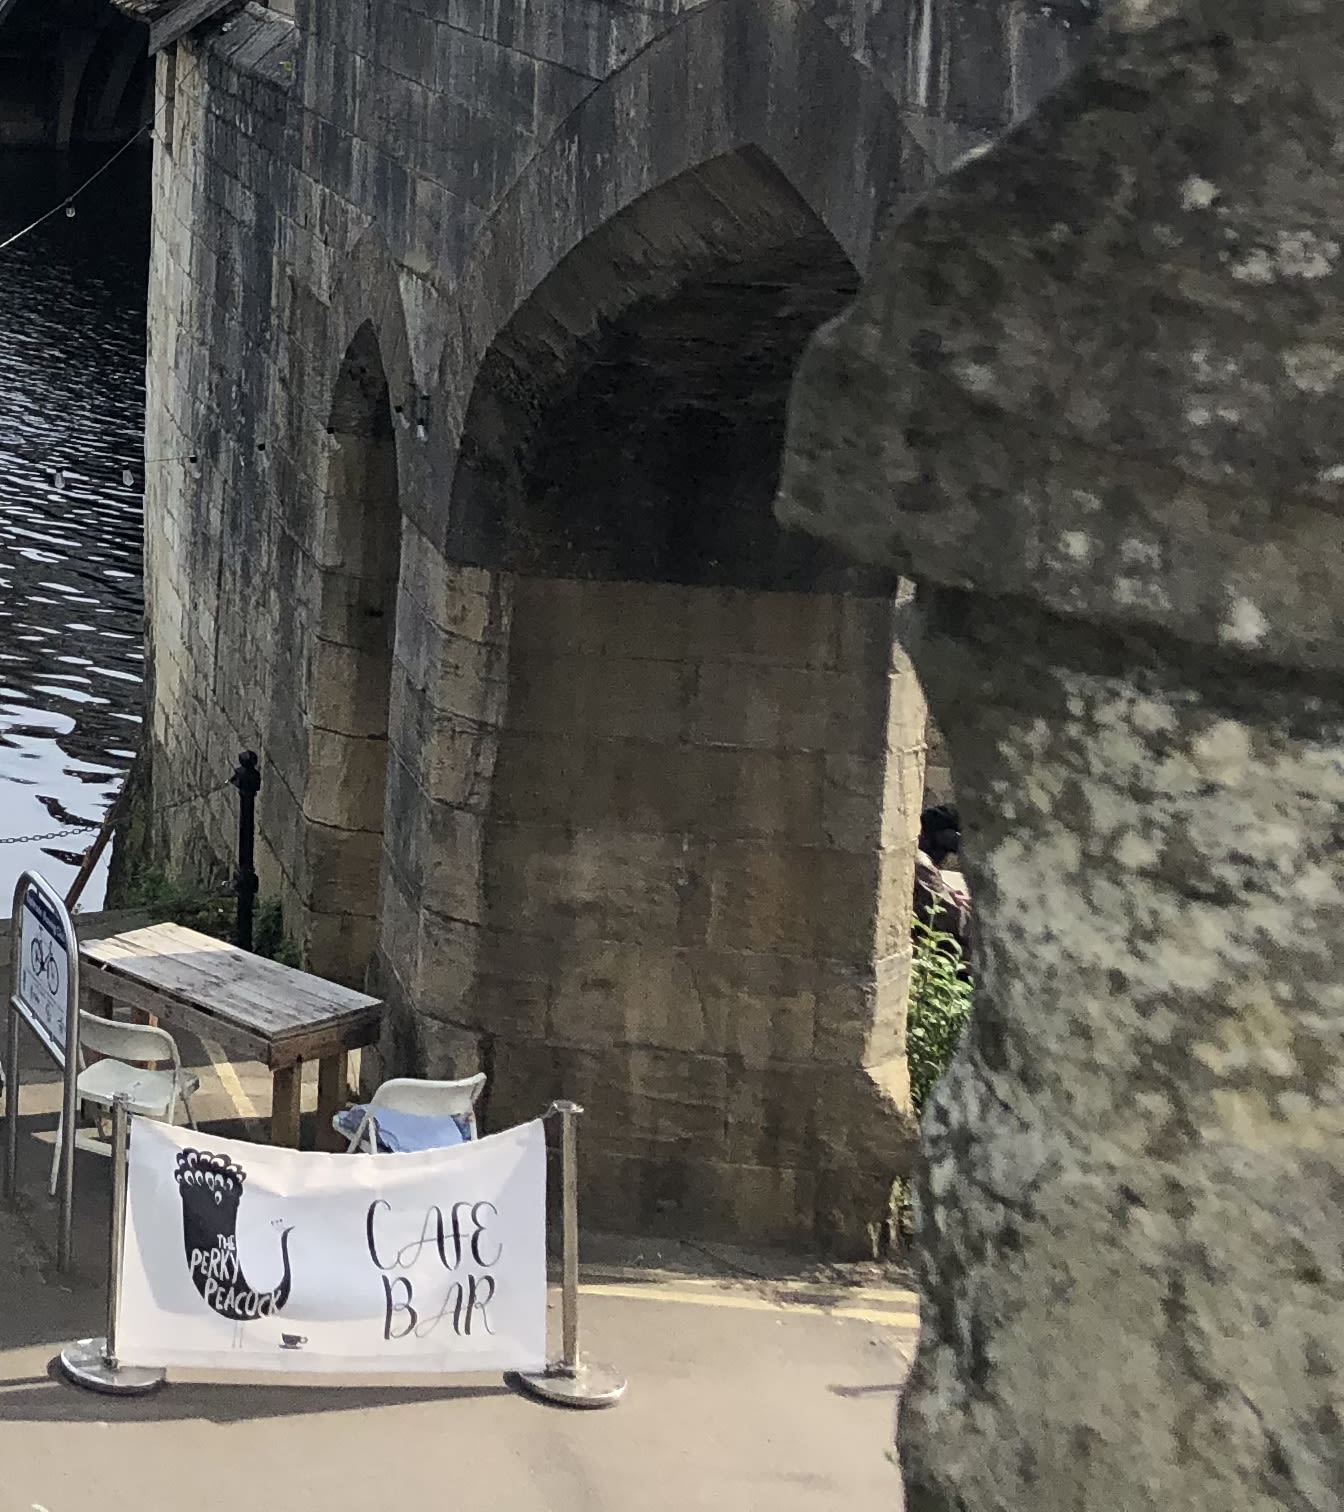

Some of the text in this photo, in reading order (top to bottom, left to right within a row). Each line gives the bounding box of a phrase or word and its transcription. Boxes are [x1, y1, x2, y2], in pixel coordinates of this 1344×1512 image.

[216, 1233, 236, 1251] THE
[366, 1199, 503, 1271] CAFE
[190, 1247, 239, 1284] PERKY
[204, 1277, 282, 1319] PEACOCK
[382, 1274, 495, 1340] BAR
